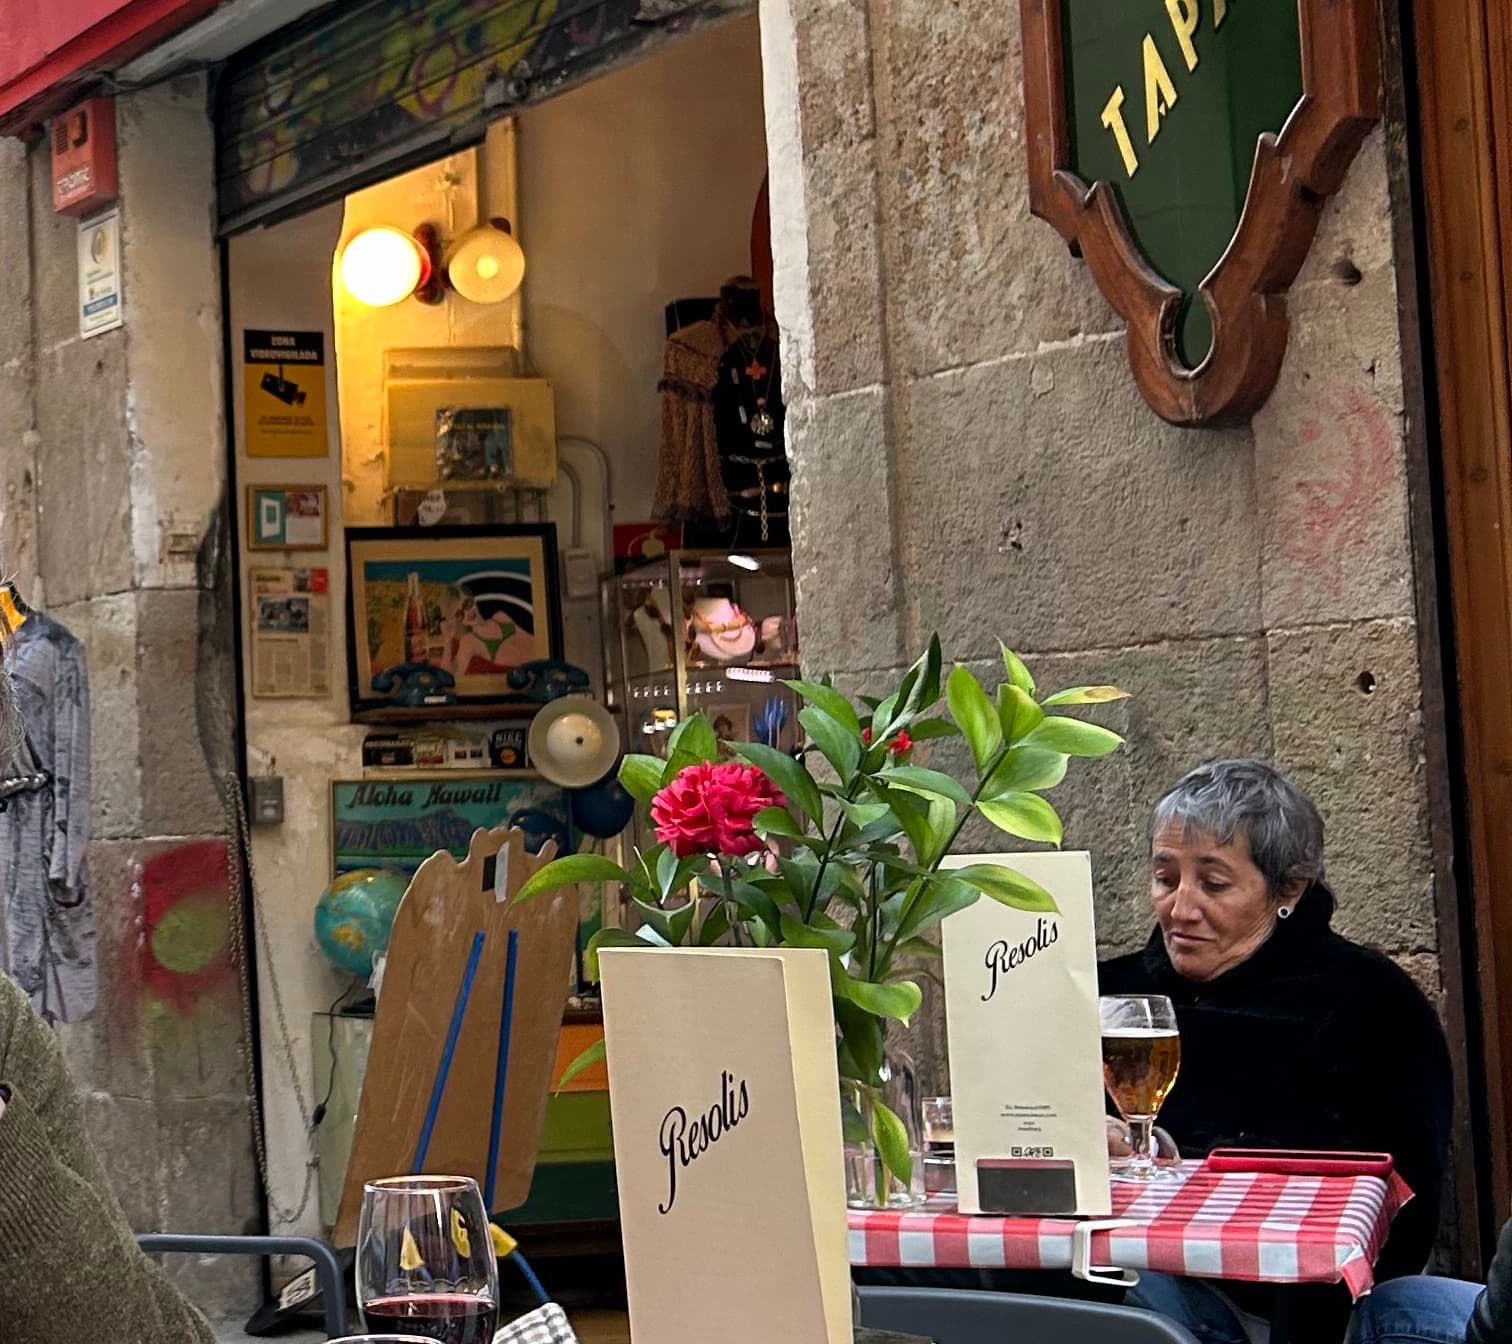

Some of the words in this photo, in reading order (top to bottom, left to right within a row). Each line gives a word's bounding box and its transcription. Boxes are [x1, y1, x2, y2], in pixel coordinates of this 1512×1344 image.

[344, 782, 413, 809] Aloha
[981, 917, 1058, 1002] Resolis
[658, 1070, 749, 1215] Resolis
